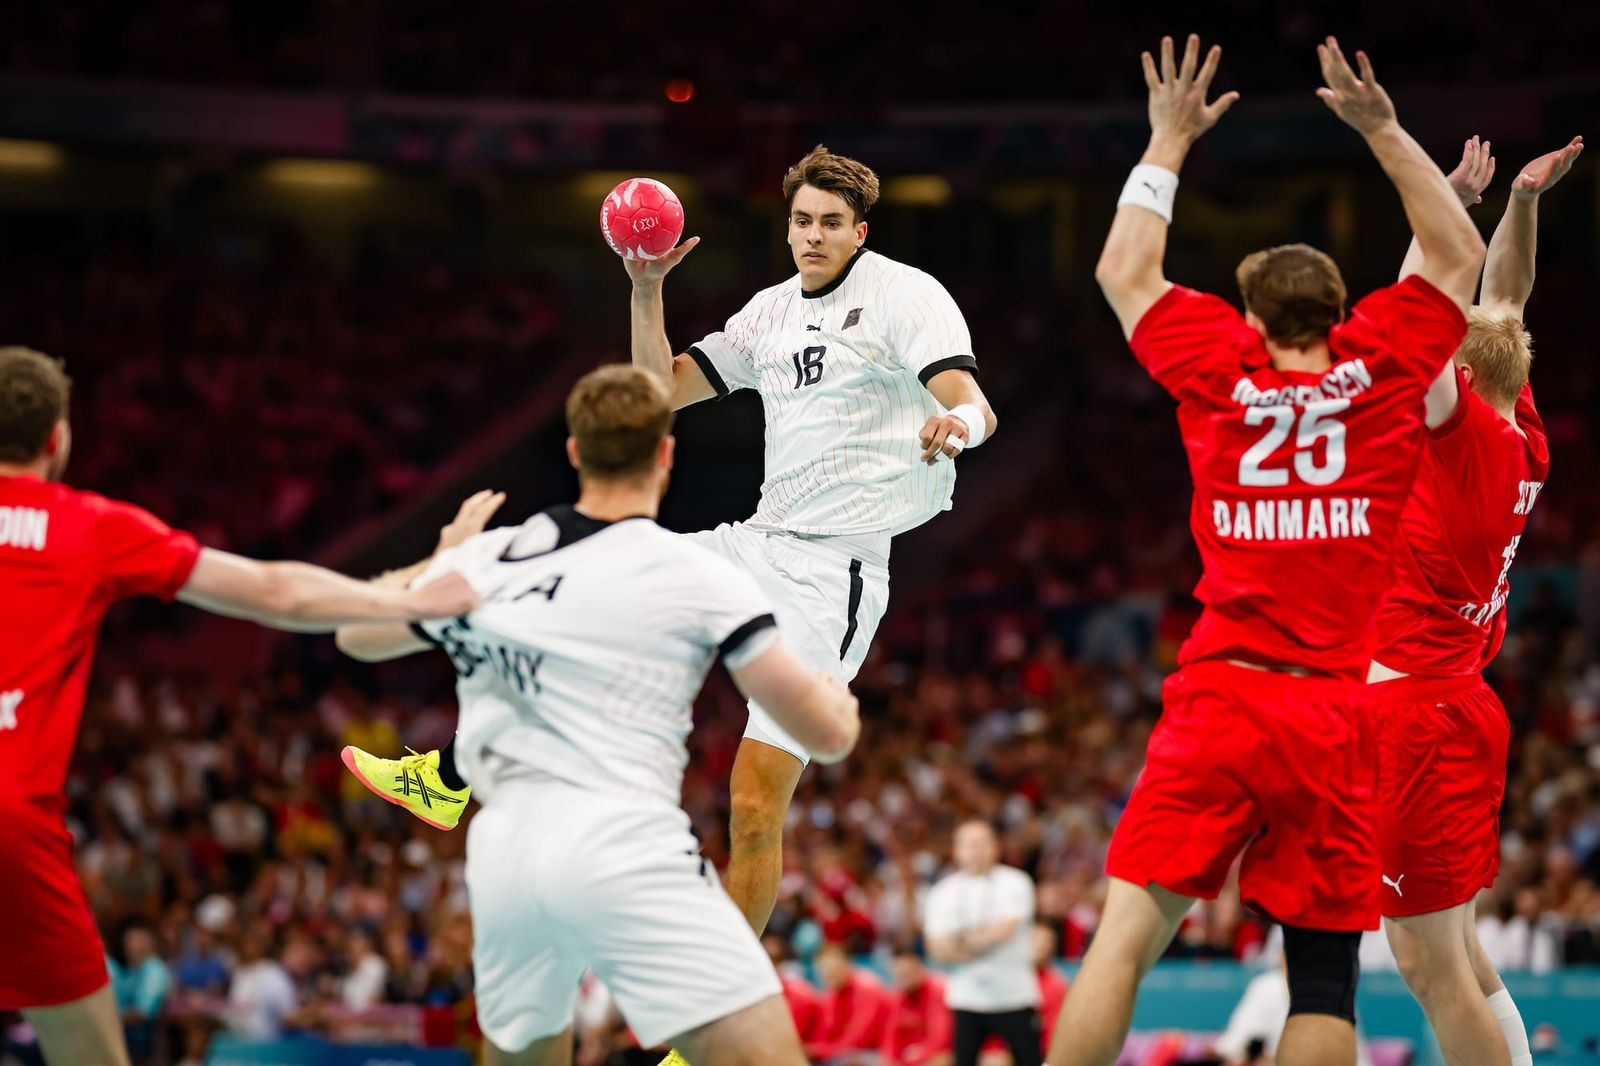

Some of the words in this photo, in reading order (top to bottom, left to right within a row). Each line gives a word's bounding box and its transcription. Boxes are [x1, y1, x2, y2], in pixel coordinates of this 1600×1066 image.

[792, 345, 827, 390] 18
[1238, 398, 1351, 487] 25
[1213, 497, 1371, 541] DANMARK
